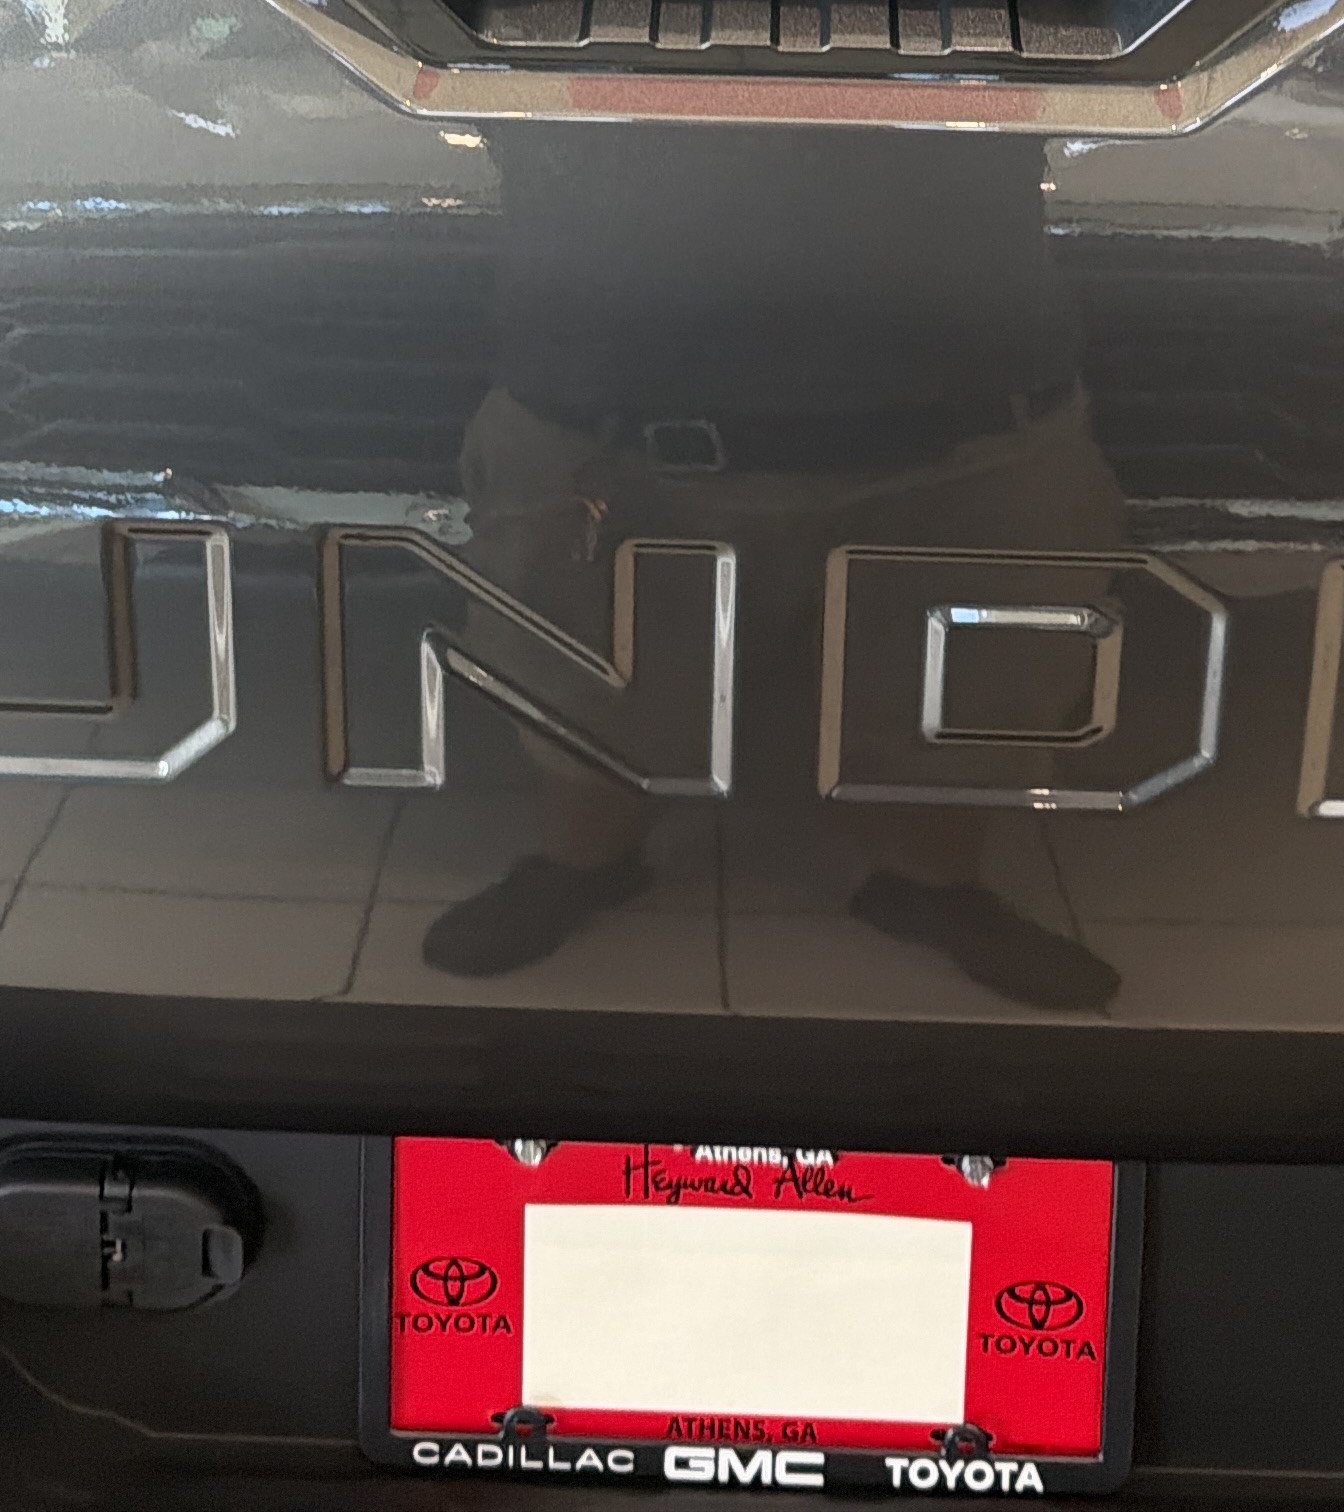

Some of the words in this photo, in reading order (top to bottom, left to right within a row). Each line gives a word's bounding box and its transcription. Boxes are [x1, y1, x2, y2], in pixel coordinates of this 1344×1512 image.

[623, 1144, 754, 1205] Heyward
[773, 1156, 875, 1202] Allen
[396, 1313, 513, 1335] TOYOTA
[978, 1333, 1097, 1361] TOYOTA
[666, 1415, 773, 1444] ATHENS,
[781, 1420, 818, 1444] GA
[412, 1441, 635, 1473] CADILLAC
[664, 1445, 825, 1487] GMC
[885, 1456, 1044, 1493] TOYOTA
